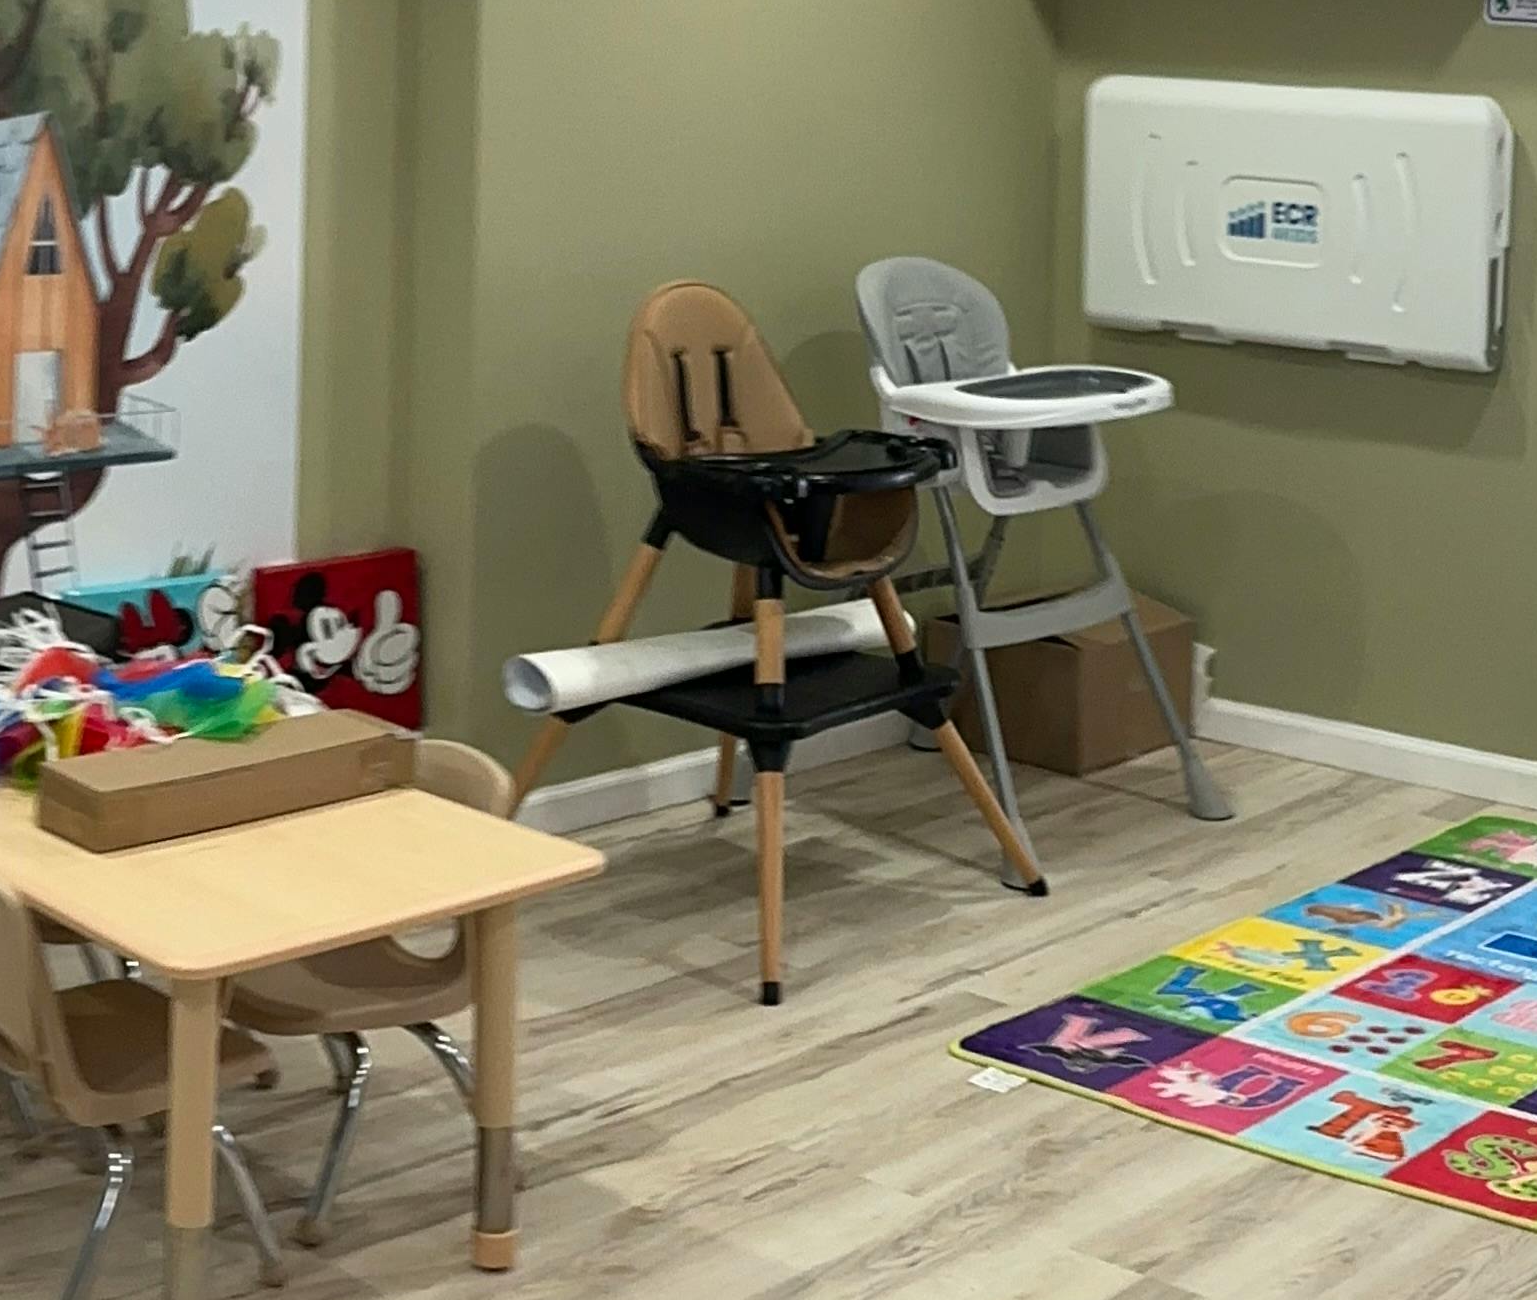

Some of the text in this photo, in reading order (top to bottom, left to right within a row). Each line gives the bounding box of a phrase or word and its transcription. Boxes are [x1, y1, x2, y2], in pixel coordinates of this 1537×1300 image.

[1272, 202, 1319, 226] ECR
[1285, 1011, 1362, 1039] 6
[1413, 1040, 1500, 1071] 7
